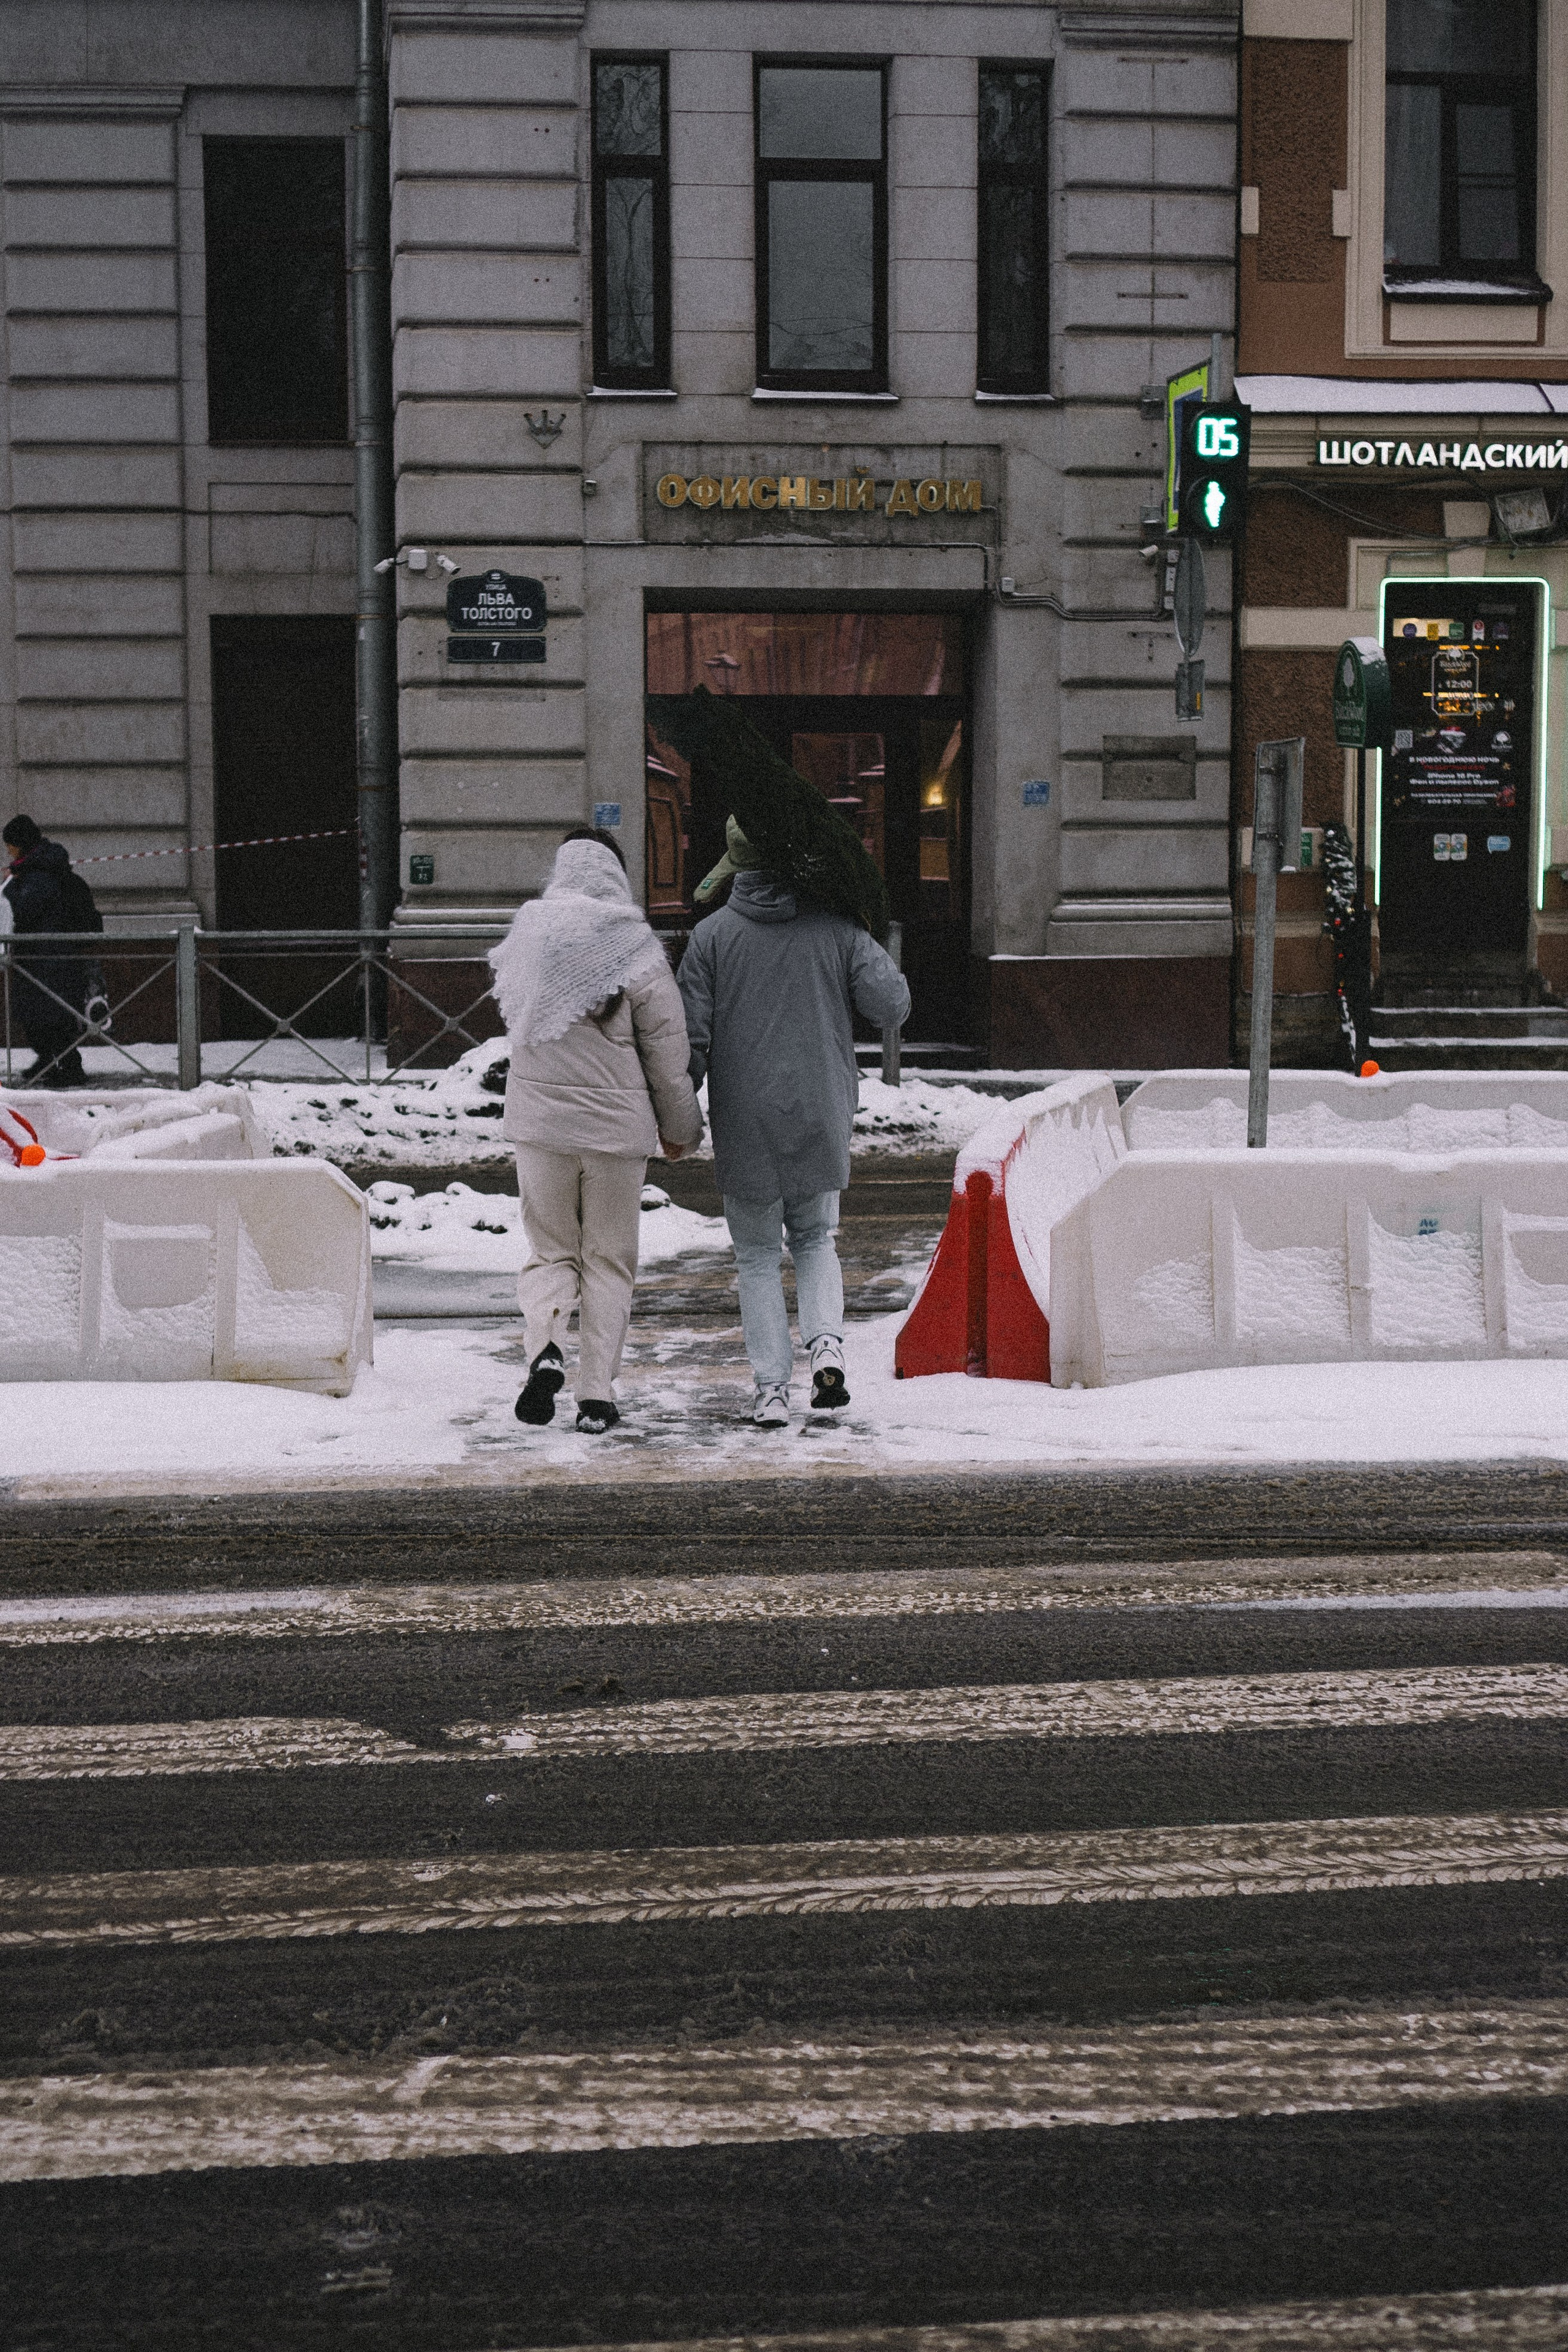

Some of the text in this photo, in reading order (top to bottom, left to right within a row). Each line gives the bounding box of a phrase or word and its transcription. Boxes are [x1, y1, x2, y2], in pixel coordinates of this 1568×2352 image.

[1198, 418, 1238, 456] 05
[1319, 439, 1568, 470] ШОТЛАНДСКИЙ
[657, 466, 981, 517] ОФИСНЫЙ ДОМ
[478, 593, 515, 605] ЛЬВА
[461, 607, 532, 620] ТОЛСТОГО
[491, 641, 500, 657] 7
